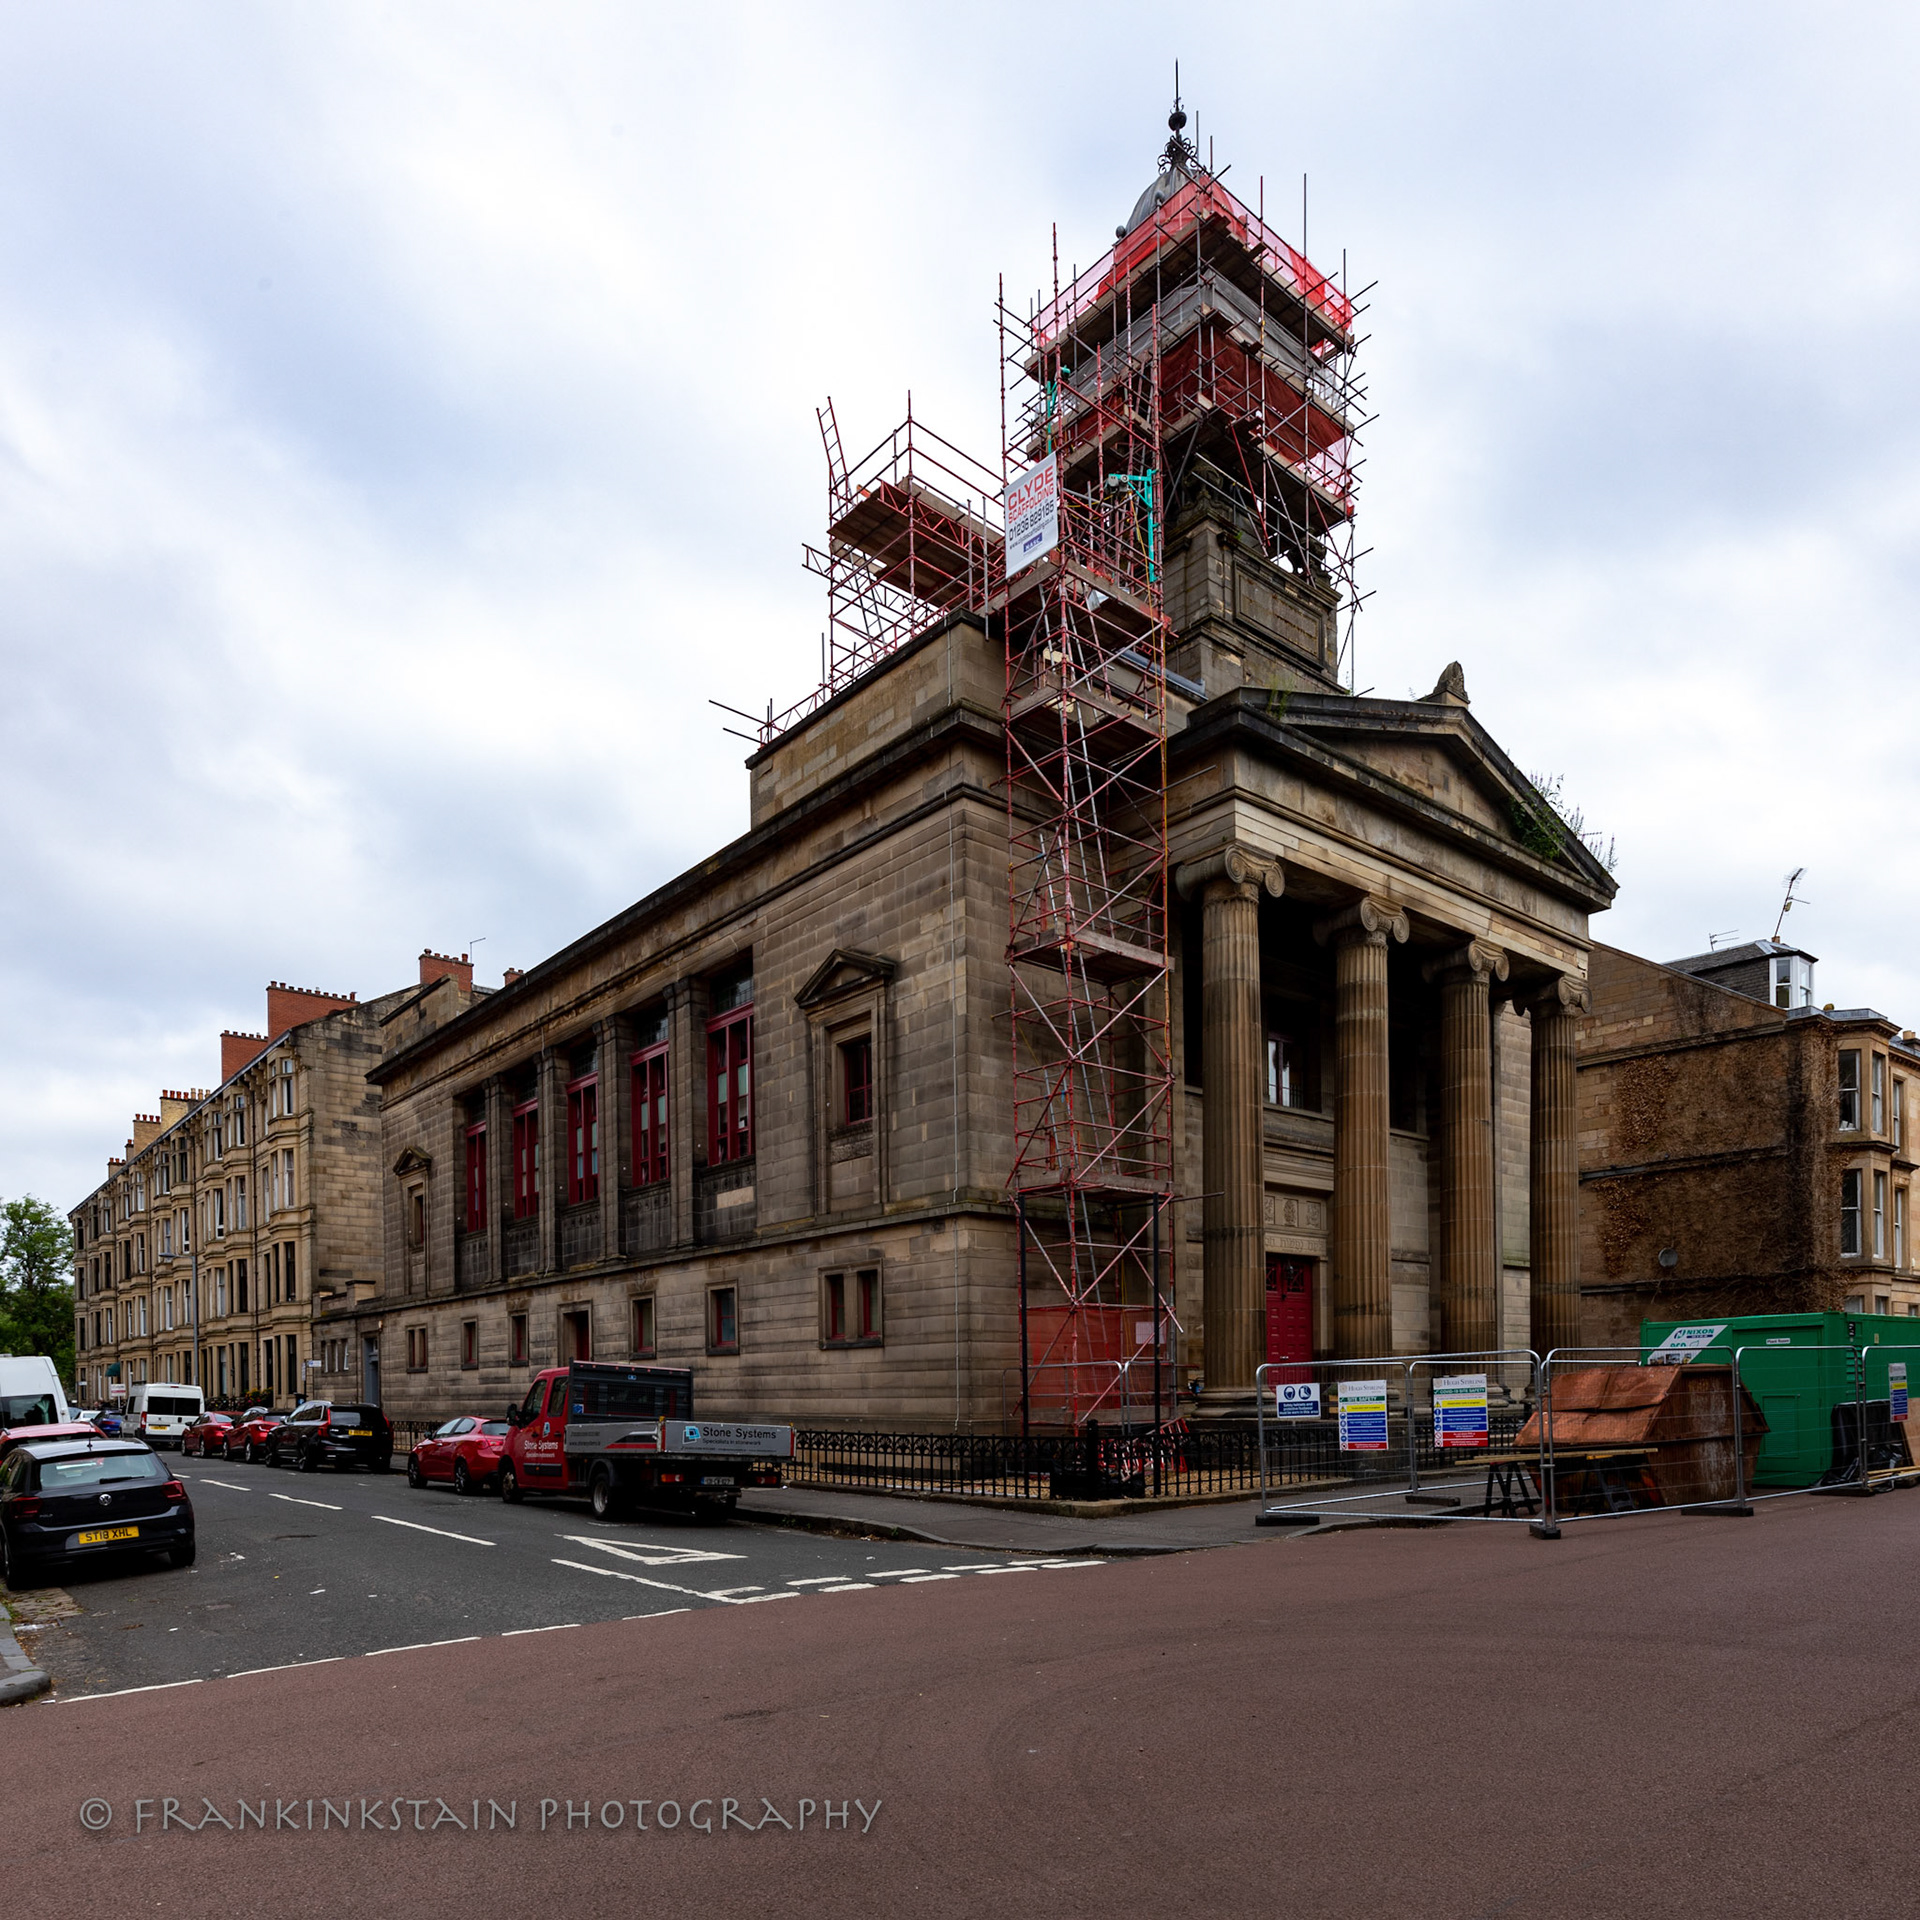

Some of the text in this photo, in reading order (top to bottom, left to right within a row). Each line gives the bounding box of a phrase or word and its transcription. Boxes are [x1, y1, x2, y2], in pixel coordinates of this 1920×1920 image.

[1008, 465, 1054, 511] CLYDE
[1008, 483, 1054, 524] SCAFFOLDING
[1009, 518, 1029, 541] 01236
[1029, 500, 1055, 528] 829185
[703, 1427, 777, 1439] Stone Systems
[524, 1440, 559, 1452] Stone Systems
[703, 1438, 729, 1446] Specialists
[86, 1528, 132, 1541] ST18 XHL
